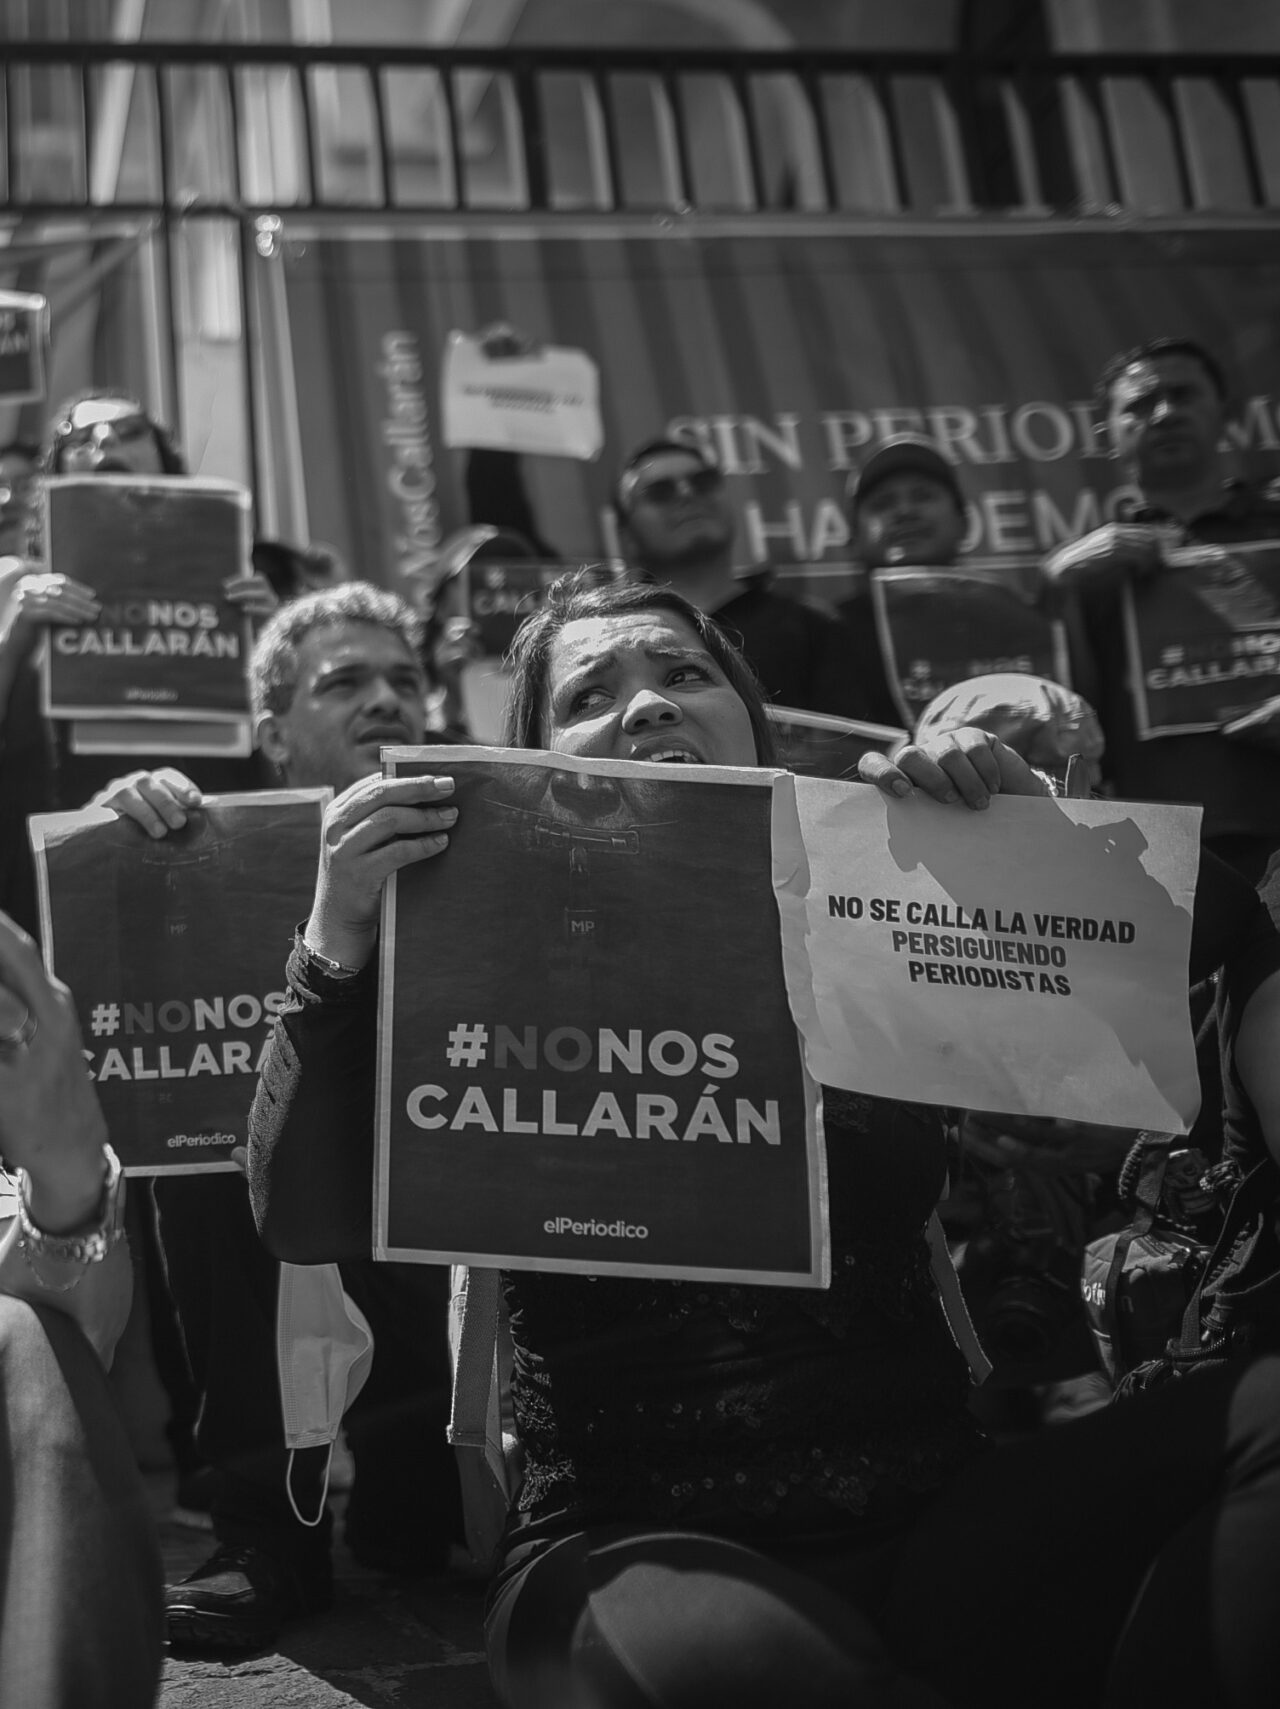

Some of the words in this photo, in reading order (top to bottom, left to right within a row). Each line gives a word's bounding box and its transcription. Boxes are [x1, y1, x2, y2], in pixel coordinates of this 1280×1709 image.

[54, 627, 240, 658] CALLARÁN
[571, 920, 595, 933] MP
[828, 895, 863, 919] NO
[870, 898, 901, 923] SE
[907, 902, 988, 931] CALLA
[995, 910, 1027, 935] LA
[1033, 914, 1136, 944] VERDAD
[892, 930, 1066, 968] PERSIGUIENDO
[908, 960, 1071, 996] PERIODISTAS
[446, 1023, 740, 1079] #NONOS
[406, 1084, 782, 1145] CALLARÁN
[167, 1132, 237, 1148] elPeriodico
[543, 1217, 649, 1240] elPeriodico
